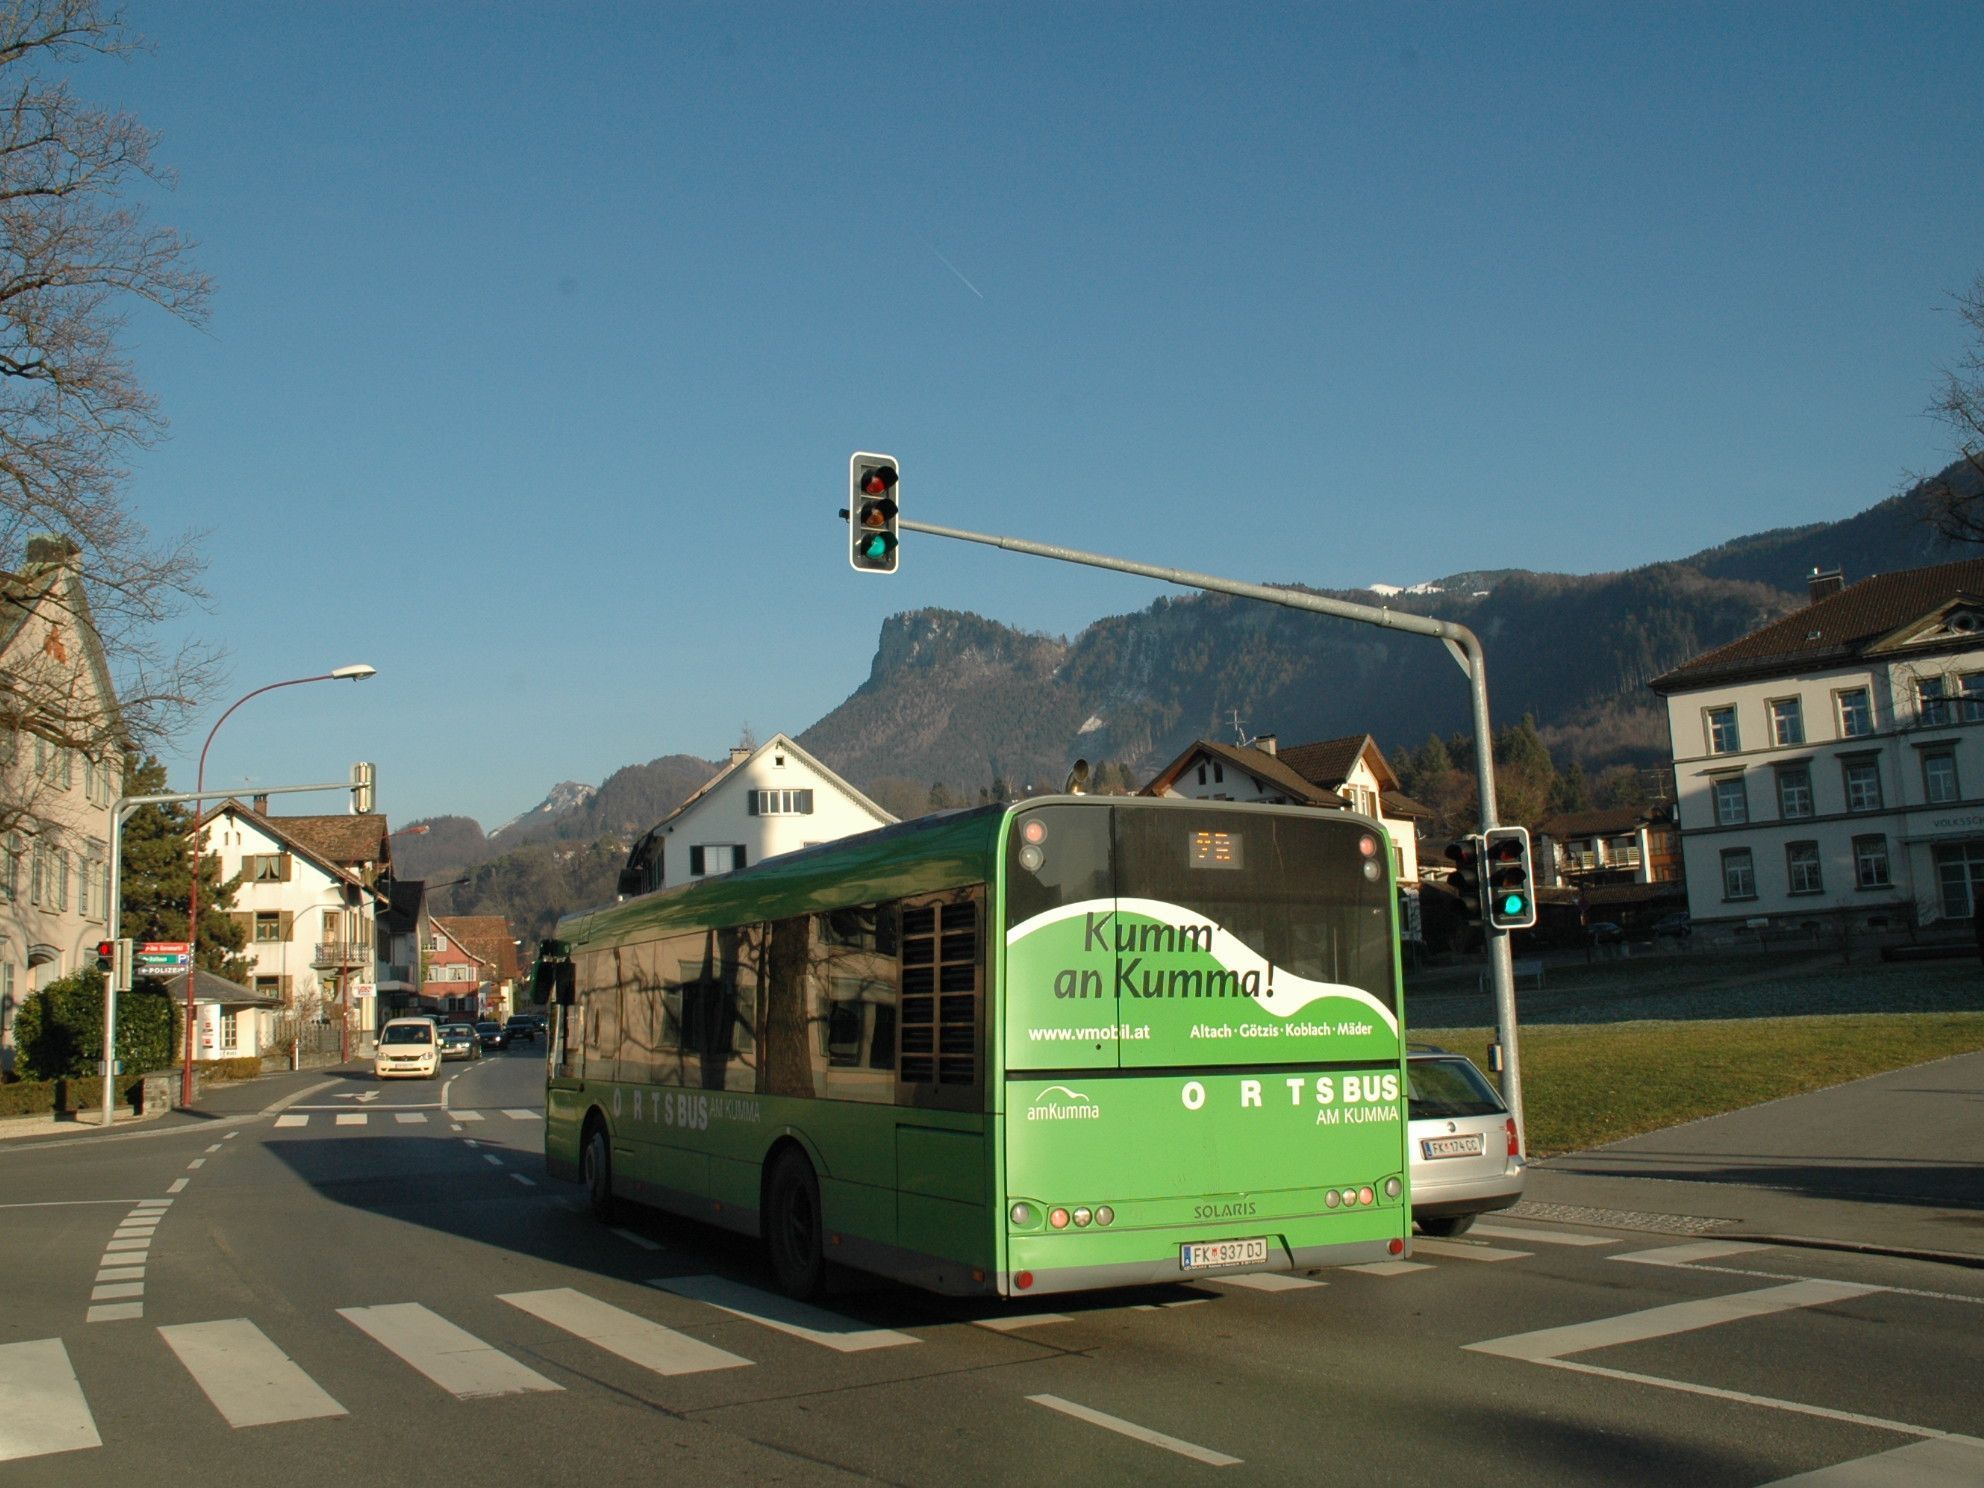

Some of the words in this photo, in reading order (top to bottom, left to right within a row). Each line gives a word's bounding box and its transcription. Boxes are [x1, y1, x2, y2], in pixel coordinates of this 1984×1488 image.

[1054, 968, 1103, 999] an
[1114, 957, 1275, 999] Kumma!
[1028, 1024, 1150, 1041] www.vmobil.at
[1190, 1024, 1232, 1039] Altach
[1239, 1023, 1279, 1038] Götzis
[1285, 1022, 1331, 1037] Koblach
[1337, 1022, 1373, 1036] Mäder
[1027, 1103, 1100, 1120] amKumma
[1316, 1108, 1340, 1125] AM
[1344, 1106, 1399, 1123] KUMMA
[1194, 1202, 1256, 1219] SOLARIS
[1194, 1247, 1210, 1263] FK
[1220, 1243, 1243, 1261] 937
[1247, 1242, 1262, 1258] DJ
